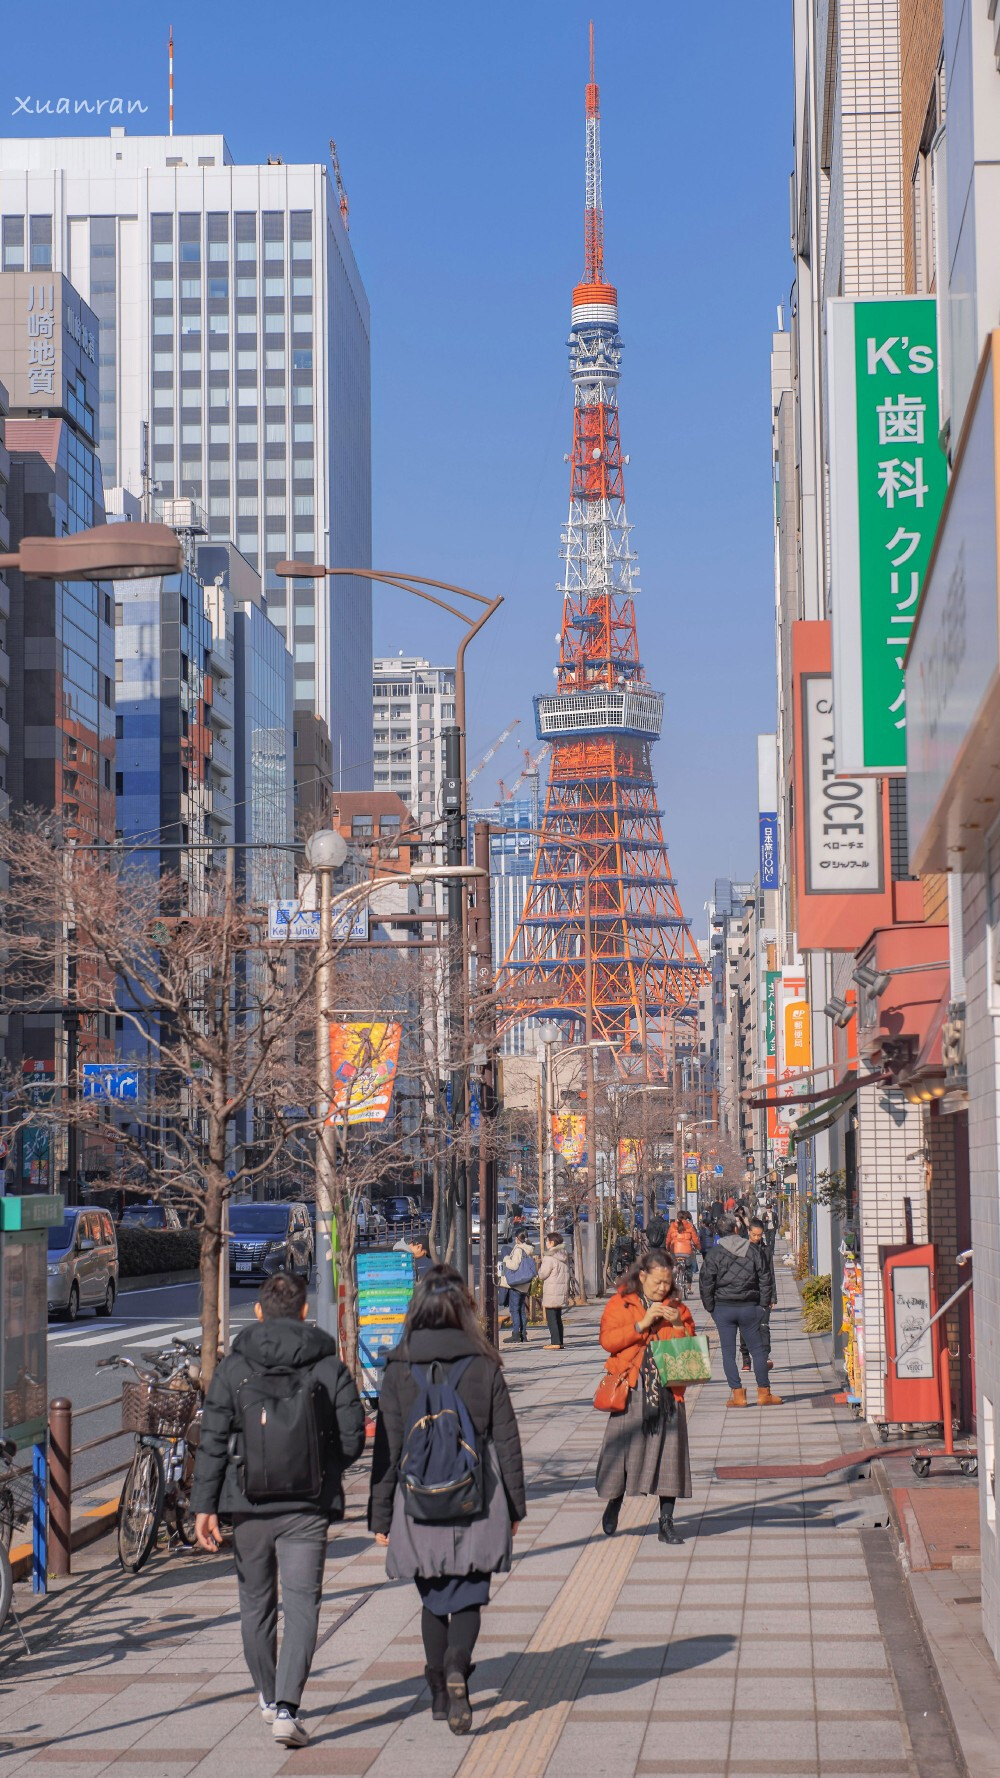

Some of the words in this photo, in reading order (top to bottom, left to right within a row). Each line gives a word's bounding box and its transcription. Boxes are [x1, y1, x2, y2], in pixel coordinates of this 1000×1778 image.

[27, 284, 55, 395] 川崎地質
[866, 336, 934, 375] K's
[764, 827, 774, 882] 日本旅行OMC
[296, 927, 318, 935] Univ.
[794, 1021, 803, 1047] 郵便局
